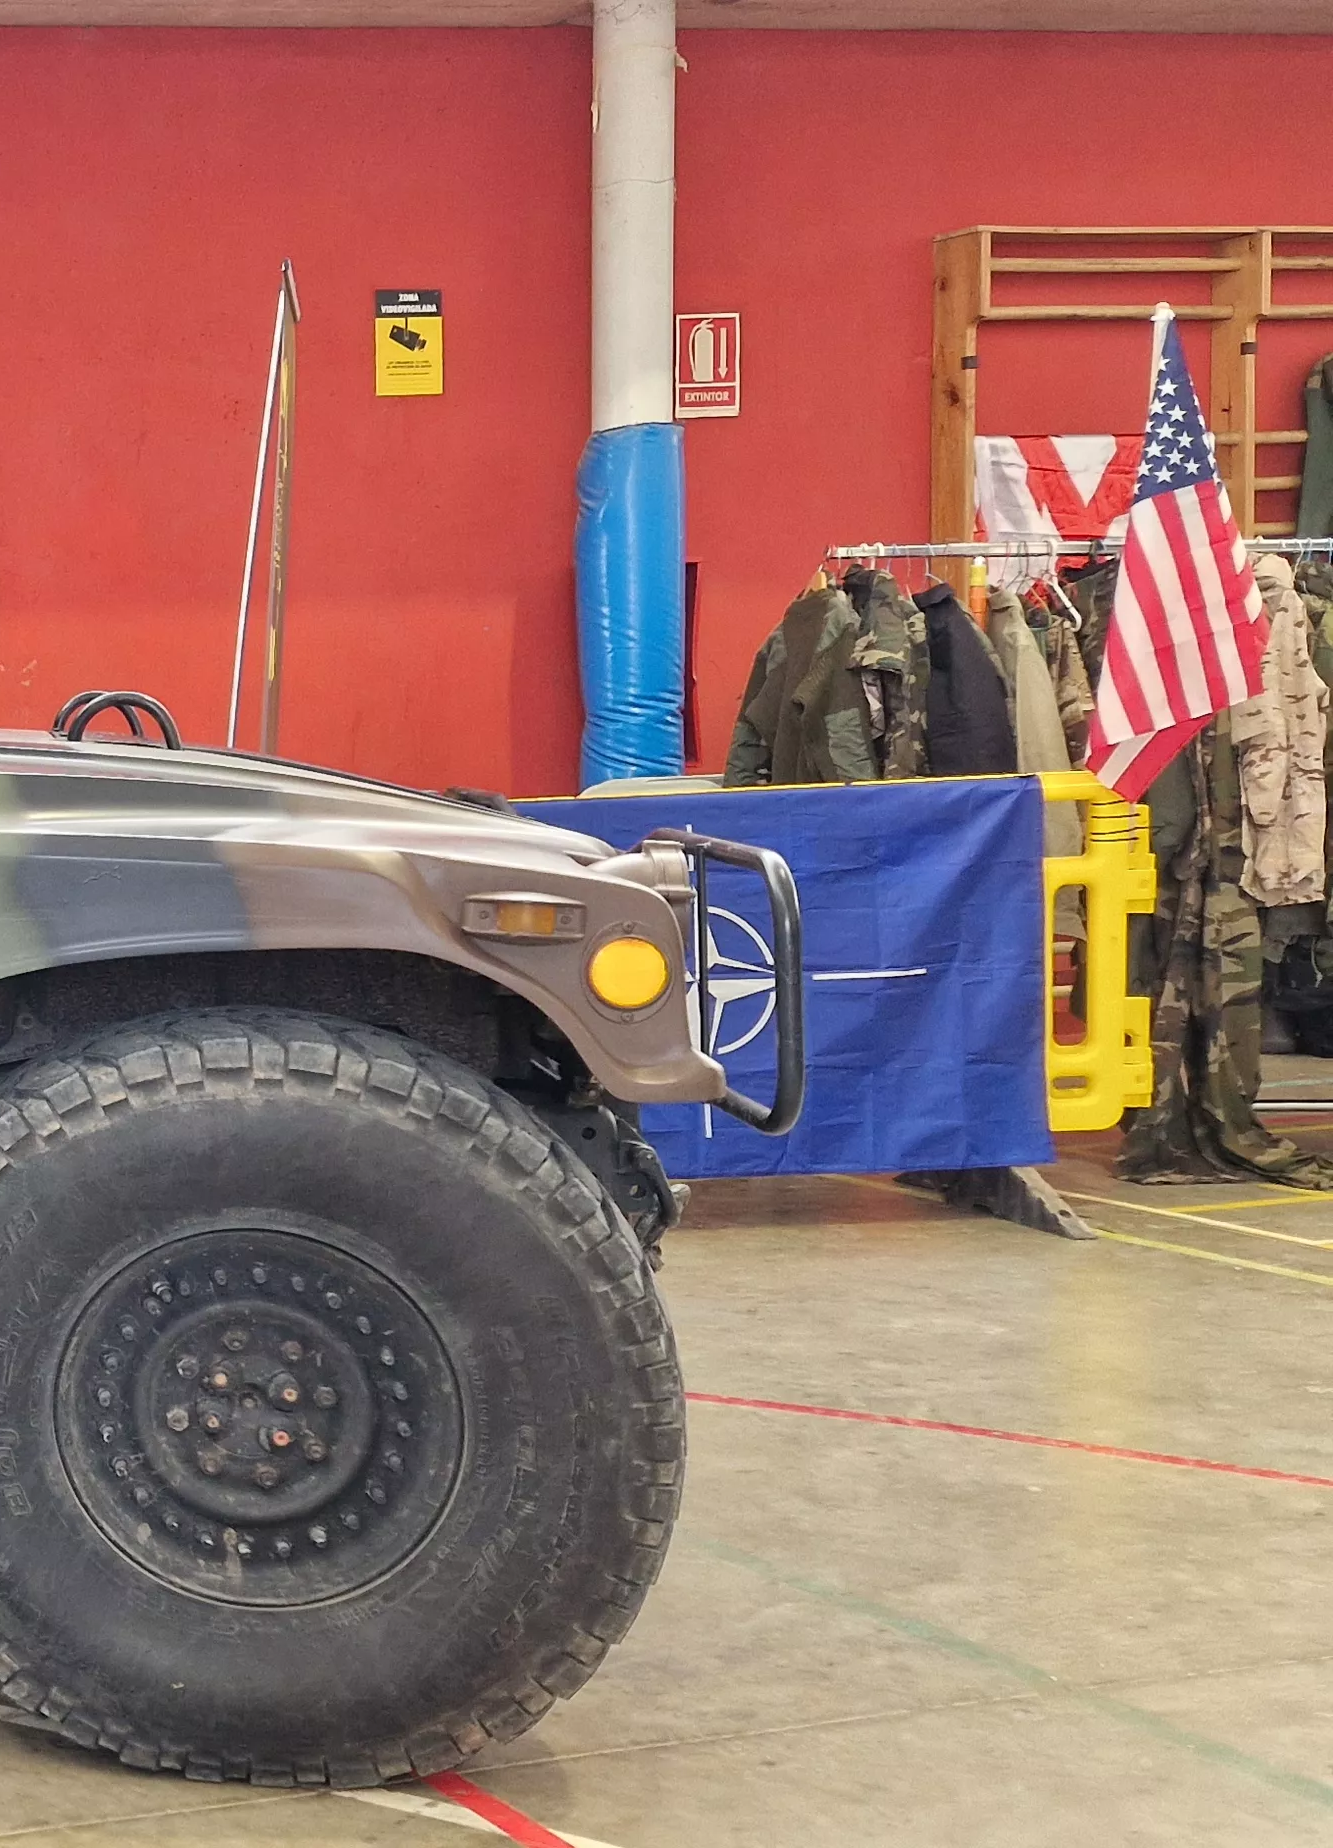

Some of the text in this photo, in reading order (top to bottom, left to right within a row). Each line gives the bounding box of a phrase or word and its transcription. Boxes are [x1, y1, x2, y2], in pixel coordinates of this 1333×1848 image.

[398, 292, 419, 302] ZONA
[380, 304, 438, 314] VIDEOVIGILADA
[684, 391, 730, 402] EXTINTOR
